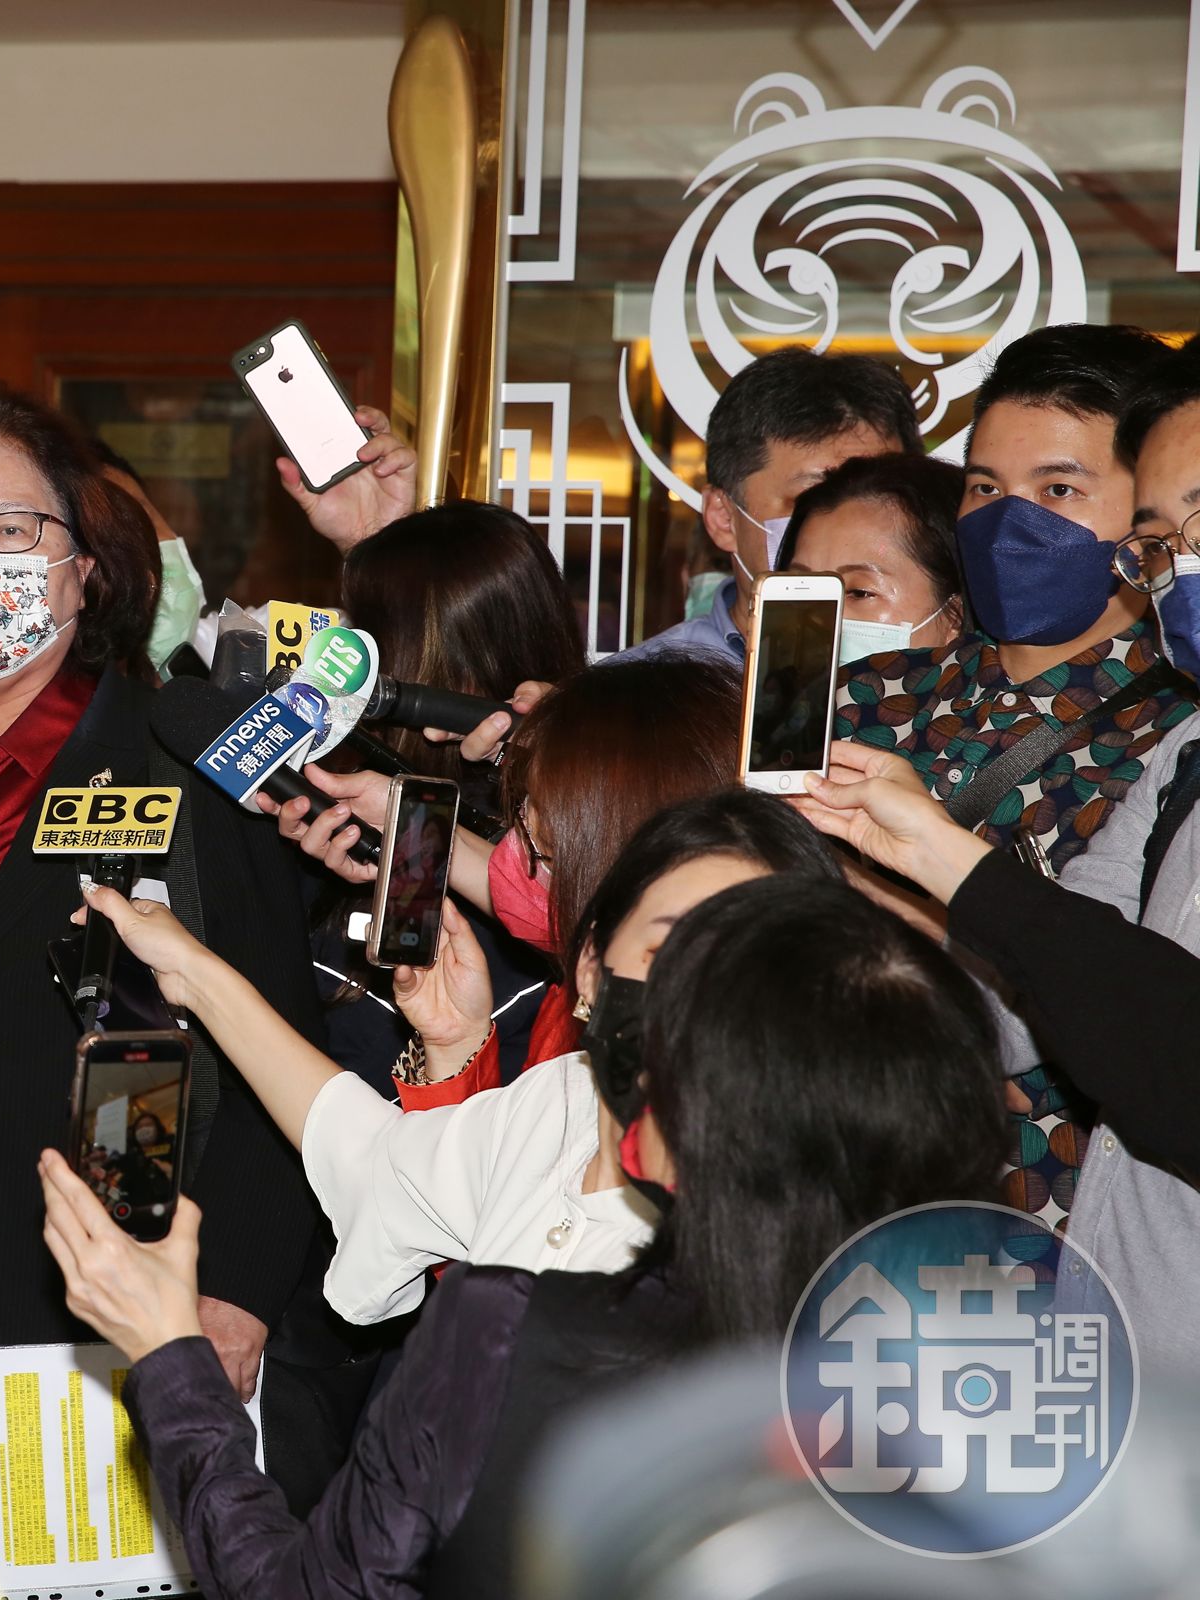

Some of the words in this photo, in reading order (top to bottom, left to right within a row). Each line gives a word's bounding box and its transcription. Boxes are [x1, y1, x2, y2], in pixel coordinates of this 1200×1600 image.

[276, 619, 302, 671] BC
[314, 635, 363, 689] CTS
[206, 702, 281, 772] mnews
[235, 723, 294, 778] 鏡新聞
[44, 794, 173, 825] EBC
[38, 829, 166, 847] 東森財經新聞
